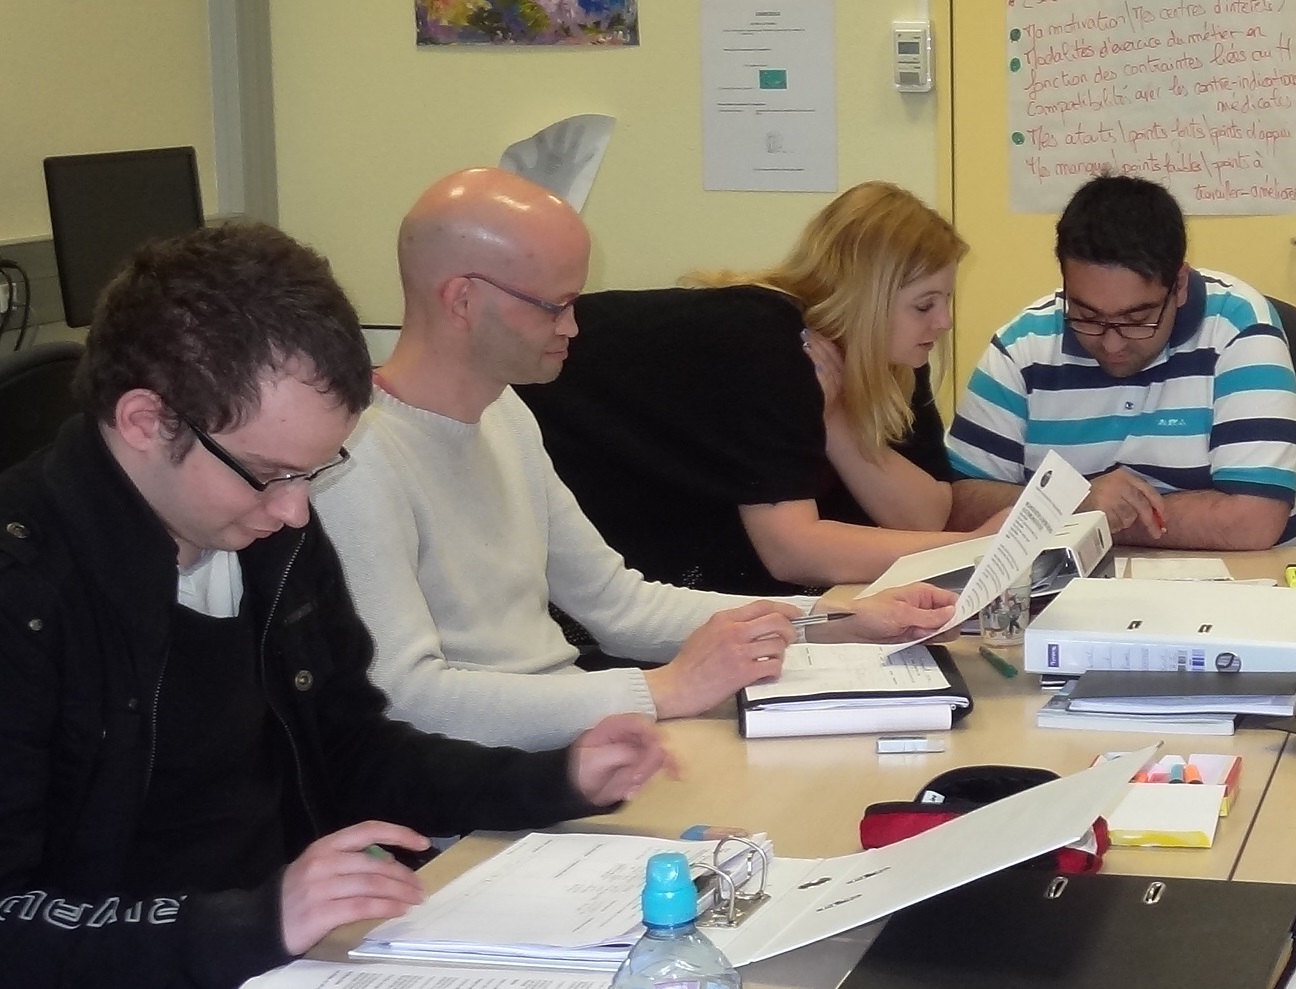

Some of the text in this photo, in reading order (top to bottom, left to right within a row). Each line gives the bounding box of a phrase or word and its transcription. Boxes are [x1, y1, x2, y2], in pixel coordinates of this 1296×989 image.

[1094, 65, 1118, 83] des
[1123, 52, 1203, 76] contraintes
[1065, 122, 1117, 145] atouts
